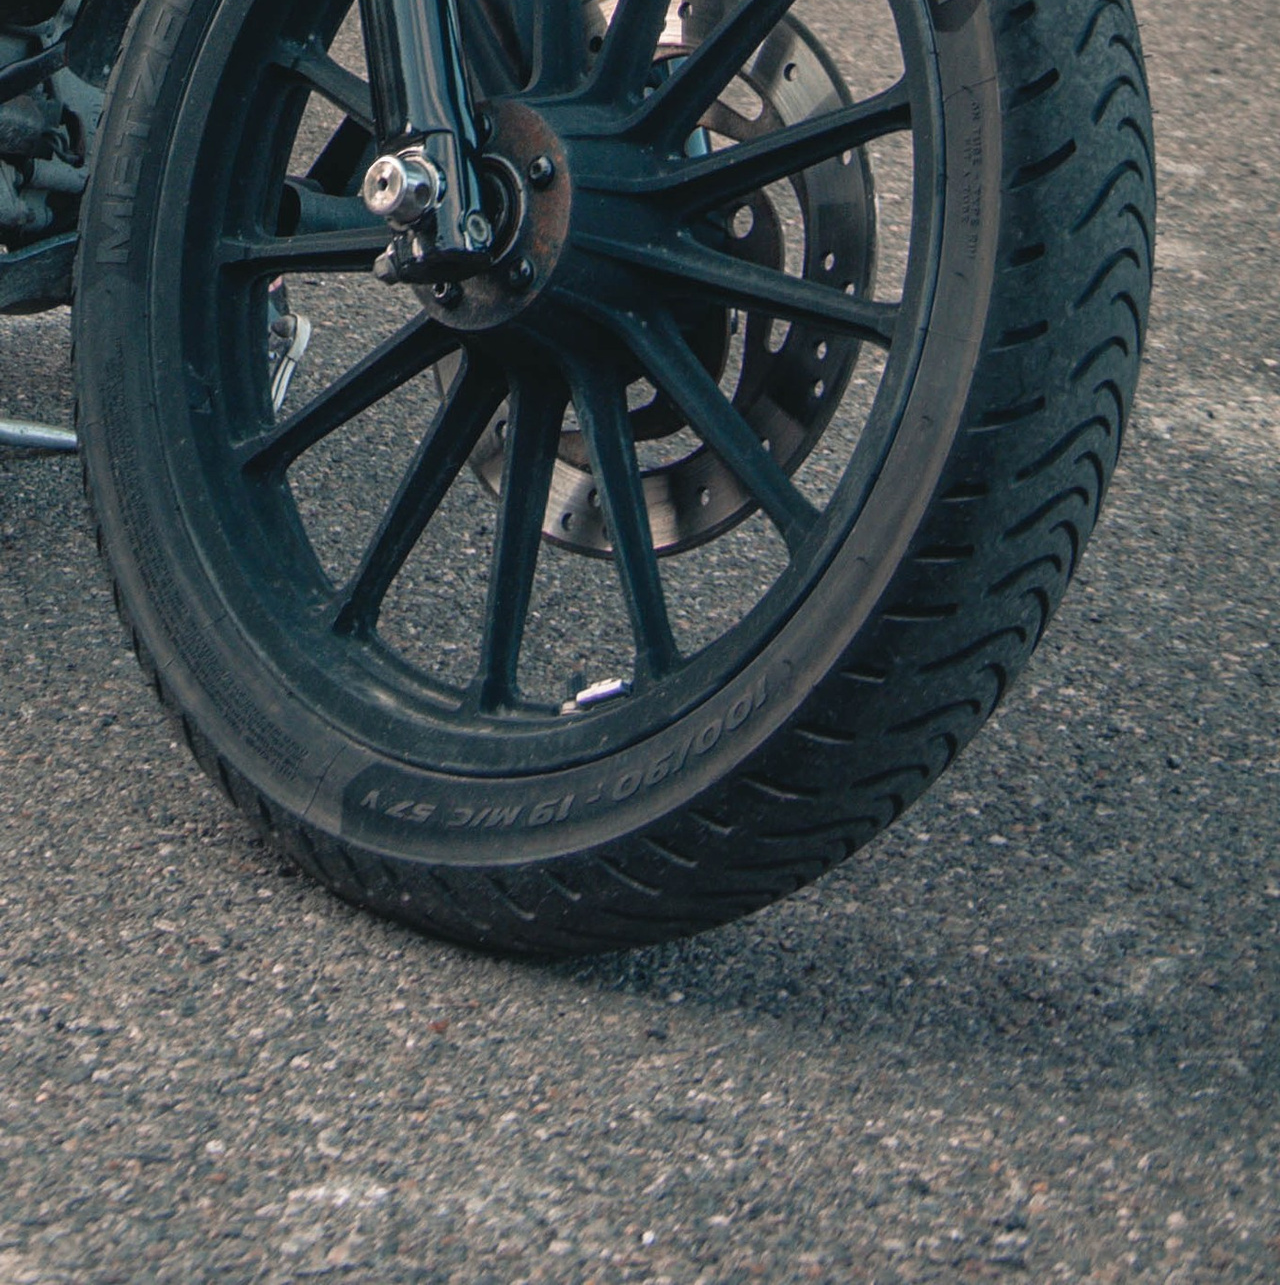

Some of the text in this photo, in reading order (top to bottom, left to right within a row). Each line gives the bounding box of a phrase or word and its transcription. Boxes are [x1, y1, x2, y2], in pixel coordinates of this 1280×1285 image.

[613, 678, 768, 802] 100/90
[444, 806, 522, 829] M/C
[525, 794, 577, 827] 19
